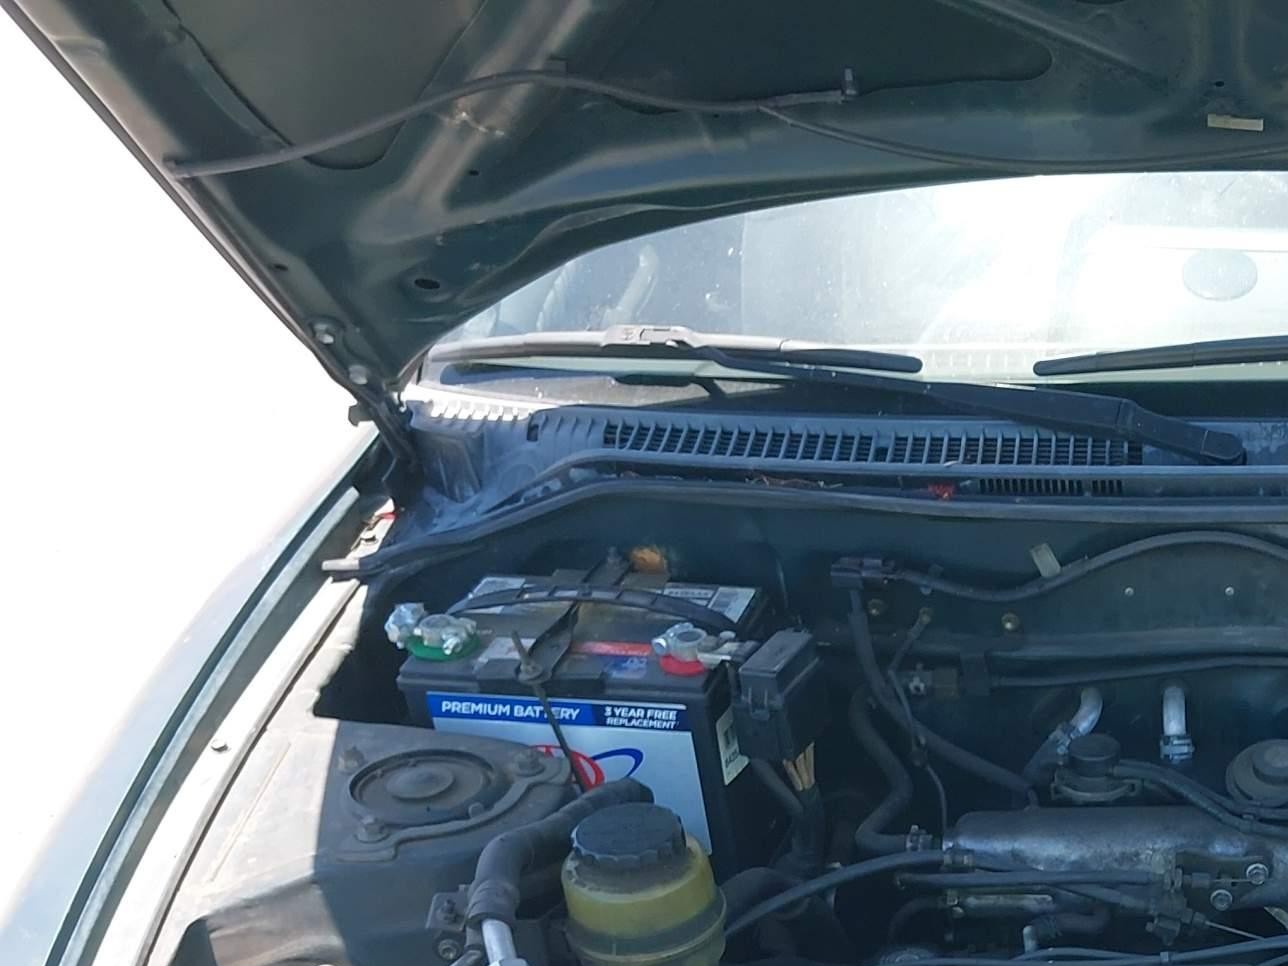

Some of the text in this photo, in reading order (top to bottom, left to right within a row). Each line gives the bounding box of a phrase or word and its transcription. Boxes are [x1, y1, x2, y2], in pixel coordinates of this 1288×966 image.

[441, 700, 510, 716] PREMIUM
[613, 707, 645, 718] YEAR
[646, 708, 678, 721] FREE
[606, 717, 676, 729] REPLACEMENT
